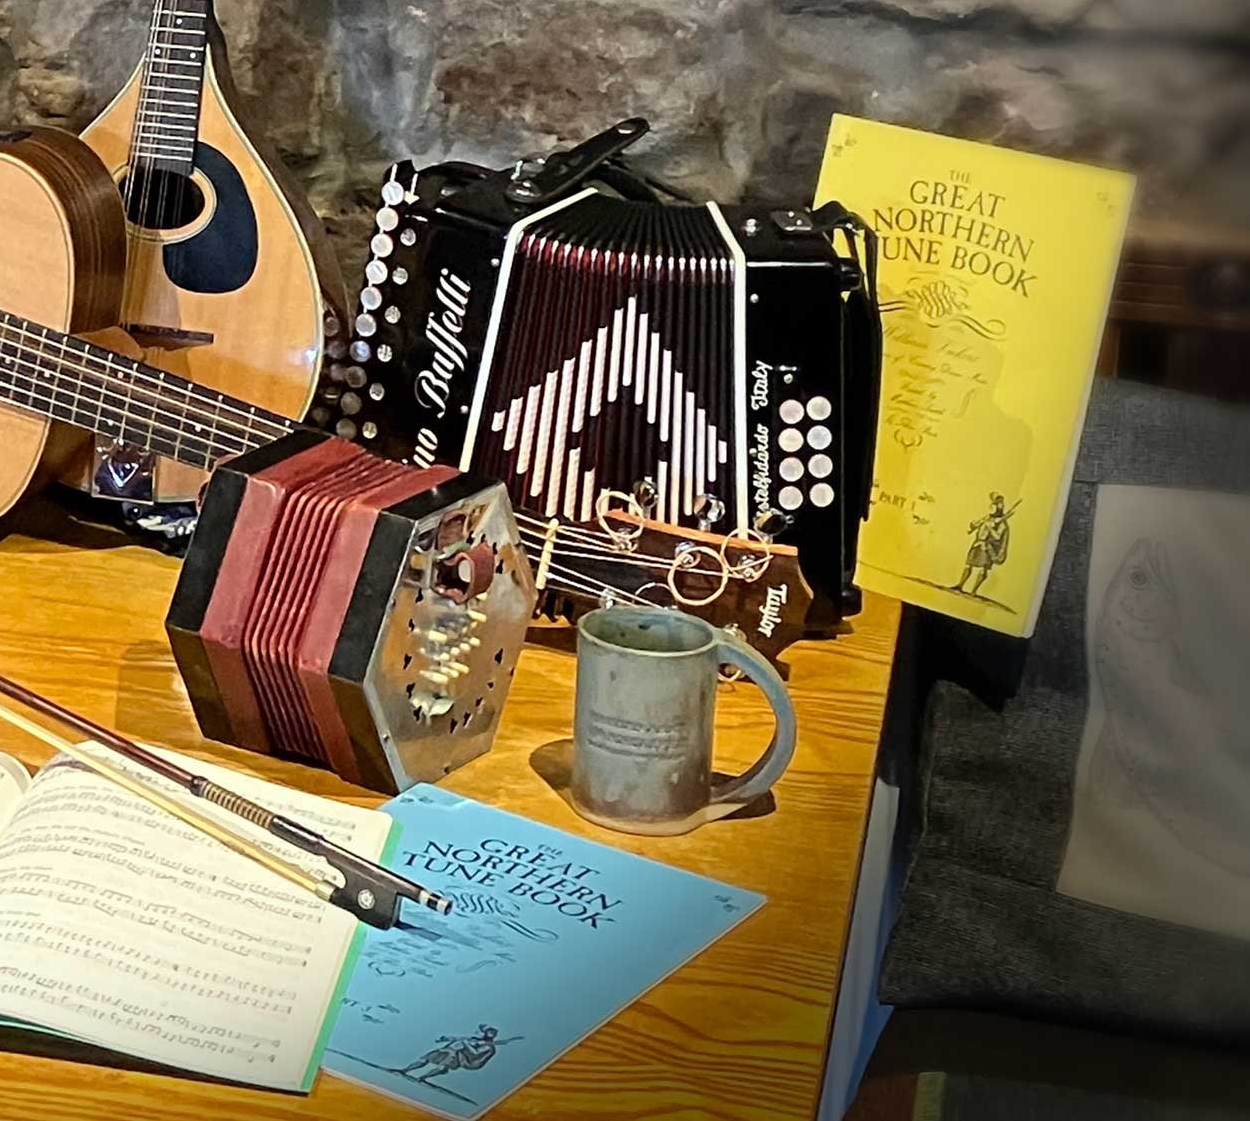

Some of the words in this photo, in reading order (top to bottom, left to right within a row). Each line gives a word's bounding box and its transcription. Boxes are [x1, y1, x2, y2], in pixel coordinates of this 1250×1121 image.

[910, 180, 1006, 219] GREAT
[873, 207, 1034, 264] NORTHERN
[881, 236, 942, 265] UNE
[950, 245, 1038, 299] BOOK
[751, 360, 773, 410] Italy
[753, 423, 771, 516] stelfidardo
[758, 583, 787, 639] Taylor
[423, 841, 623, 911] NORTHERN
[480, 839, 600, 880] GREAT
[402, 851, 504, 888] TUNE
[508, 882, 617, 929] BOOK
